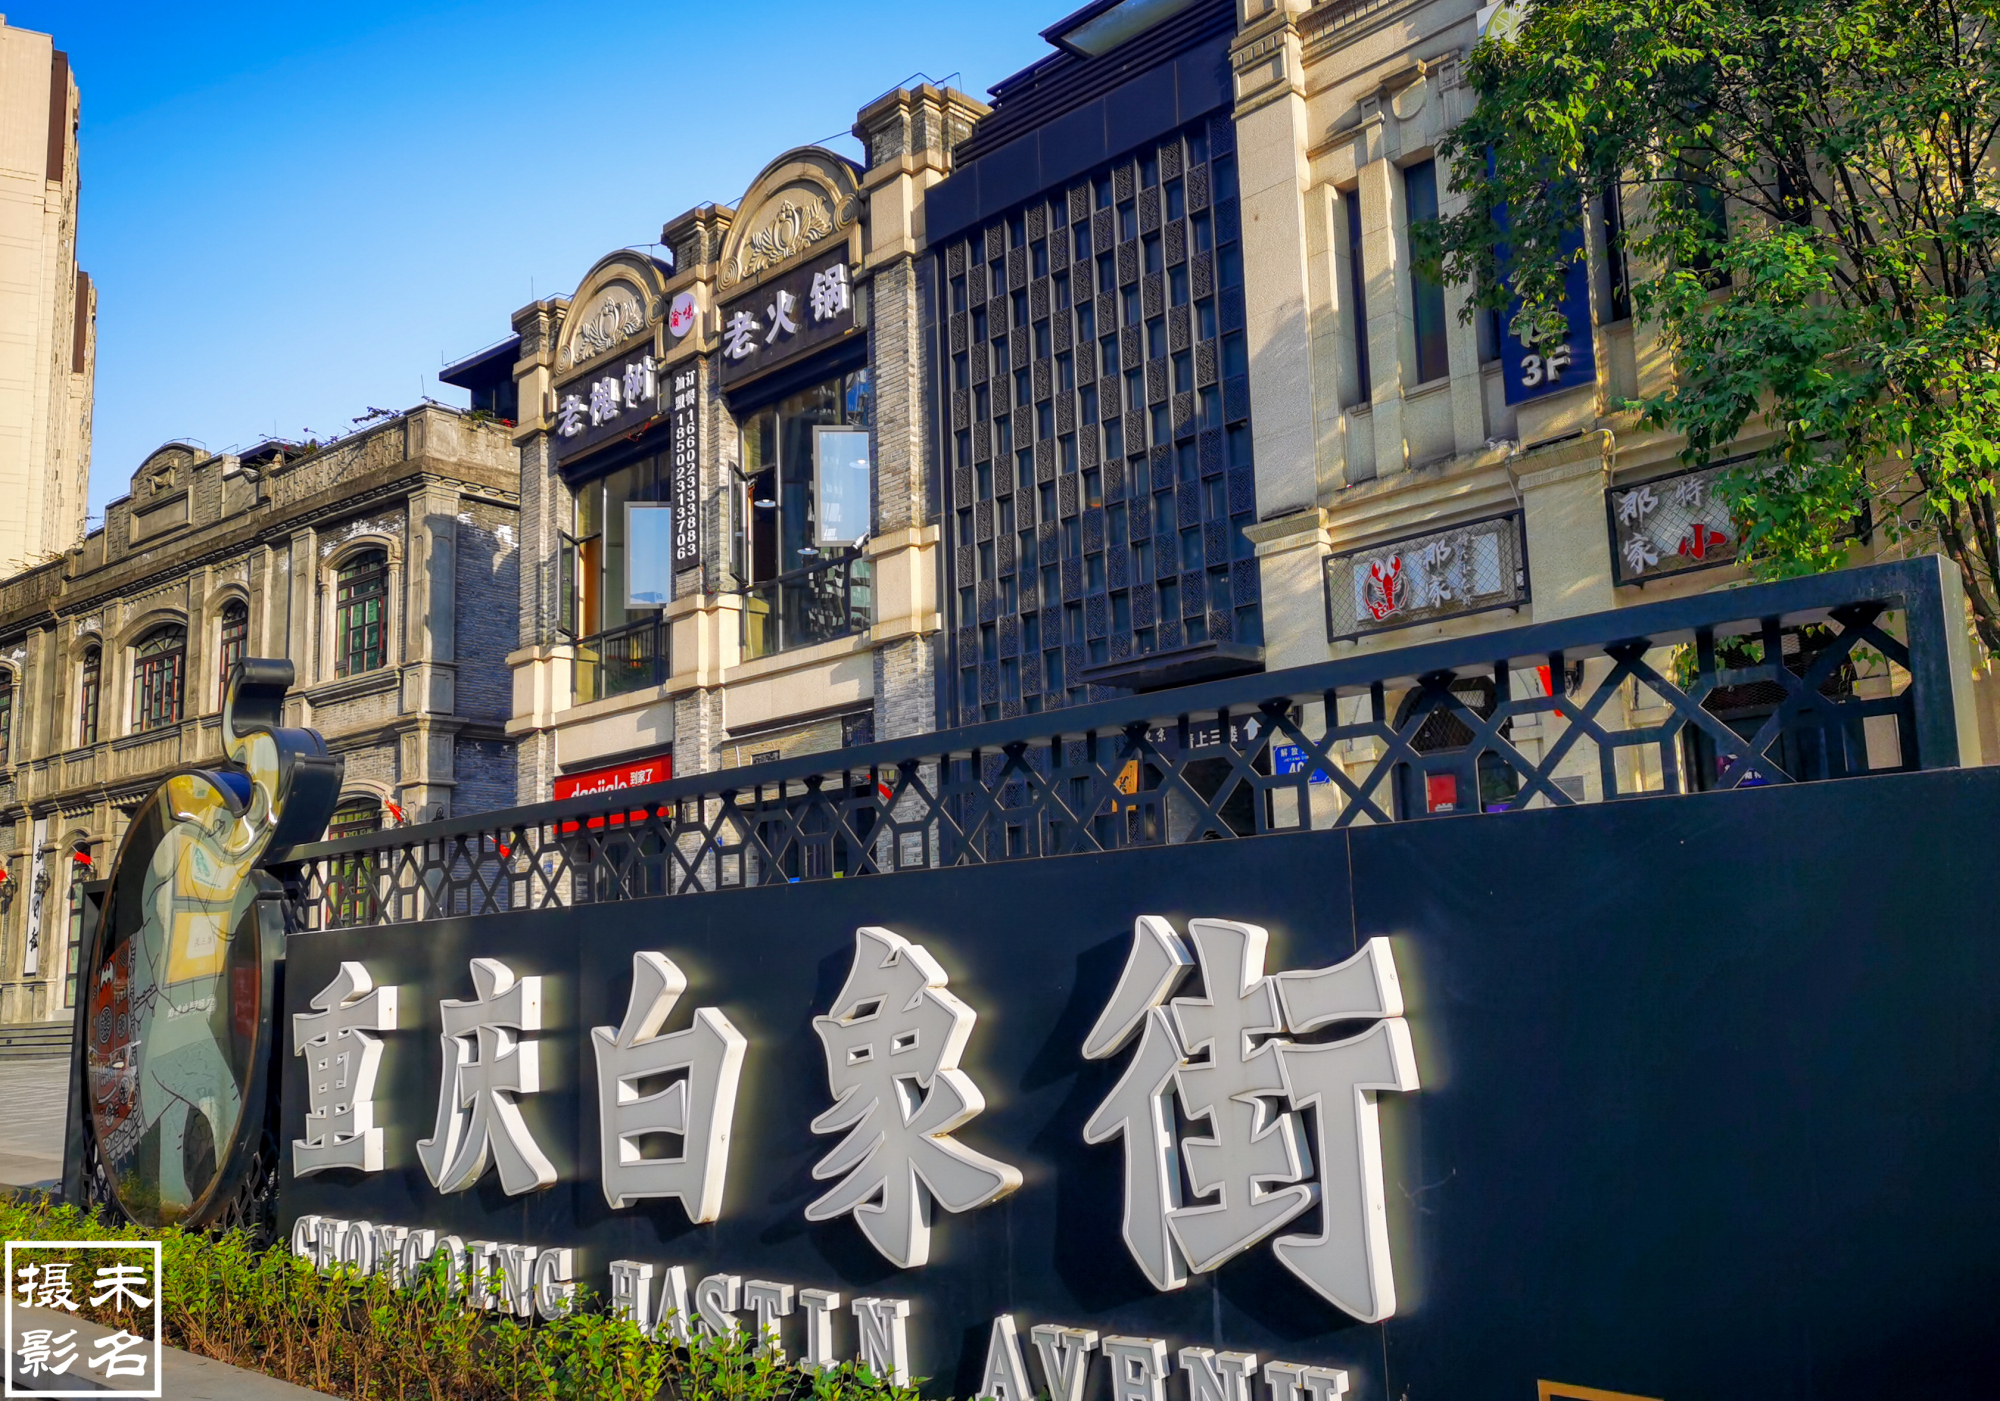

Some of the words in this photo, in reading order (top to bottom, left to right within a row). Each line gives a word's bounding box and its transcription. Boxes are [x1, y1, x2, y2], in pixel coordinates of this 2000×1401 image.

[723, 263, 850, 360] 老火锅
[557, 355, 656, 437] 老槐树
[1521, 344, 1571, 388] 3F
[629, 768, 654, 786] 到家了
[1280, 746, 1305, 758] 解放
[291, 914, 1421, 1323] 重庆白象街
[609, 1259, 911, 1389] HASTIN
